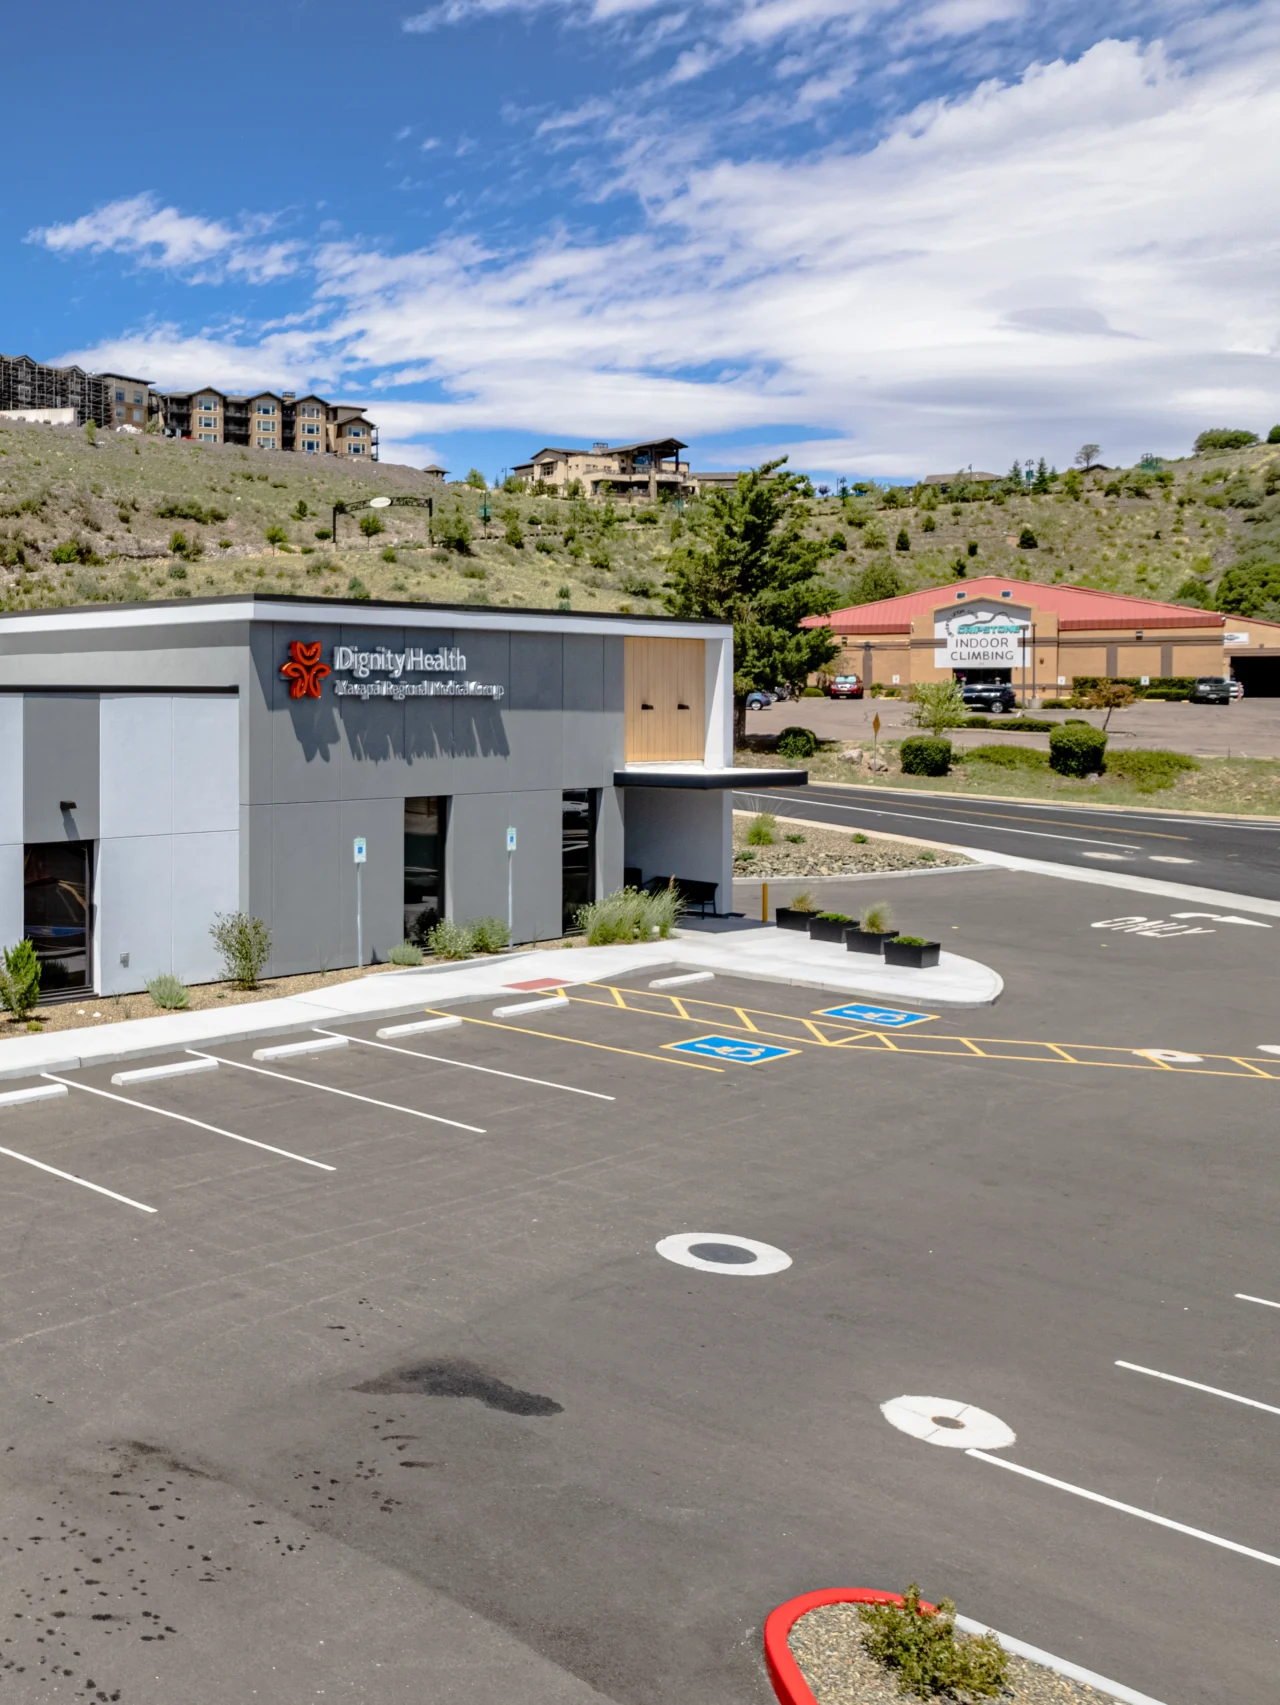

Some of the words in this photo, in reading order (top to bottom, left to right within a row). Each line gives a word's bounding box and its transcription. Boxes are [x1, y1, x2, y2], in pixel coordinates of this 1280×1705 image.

[955, 638, 1009, 648] INDOOR
[334, 647, 405, 678] Dignity
[407, 647, 467, 672] Health
[950, 651, 1014, 661] CLIMBING
[385, 681, 428, 700] Regional
[430, 681, 469, 696] Medical
[470, 681, 505, 700] Group
[1090, 916, 1217, 938] ONLY
